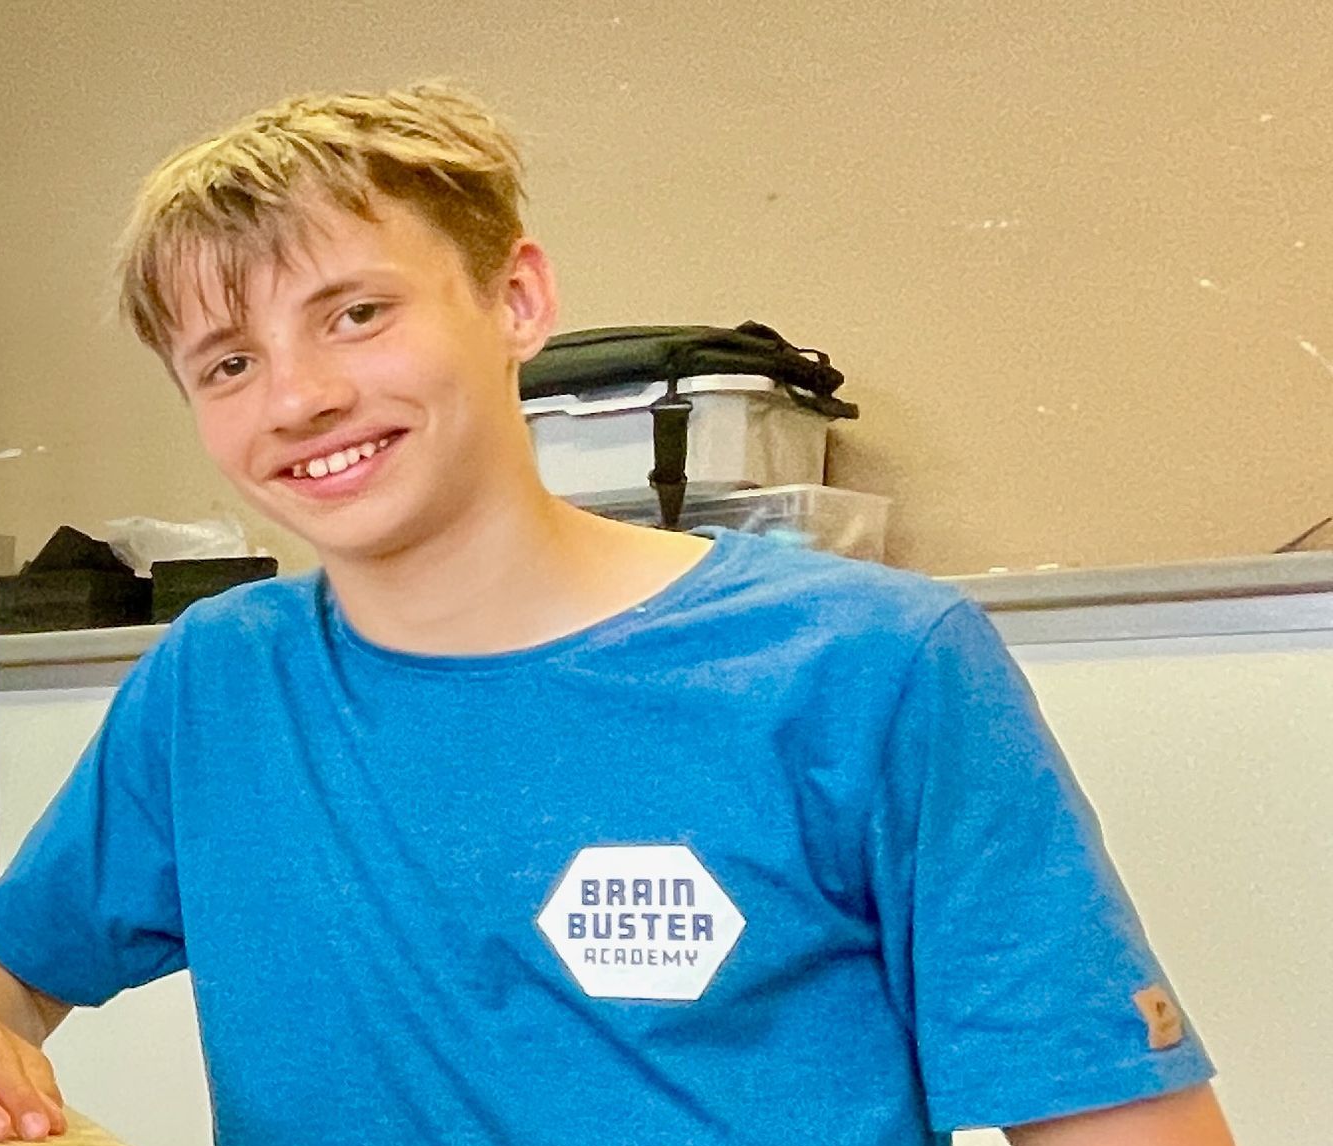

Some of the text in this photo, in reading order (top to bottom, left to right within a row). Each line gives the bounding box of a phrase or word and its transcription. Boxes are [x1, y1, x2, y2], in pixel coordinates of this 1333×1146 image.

[581, 879, 695, 907] BRAIN
[568, 913, 714, 941] BUSTER
[584, 948, 698, 967] ACADEMY
